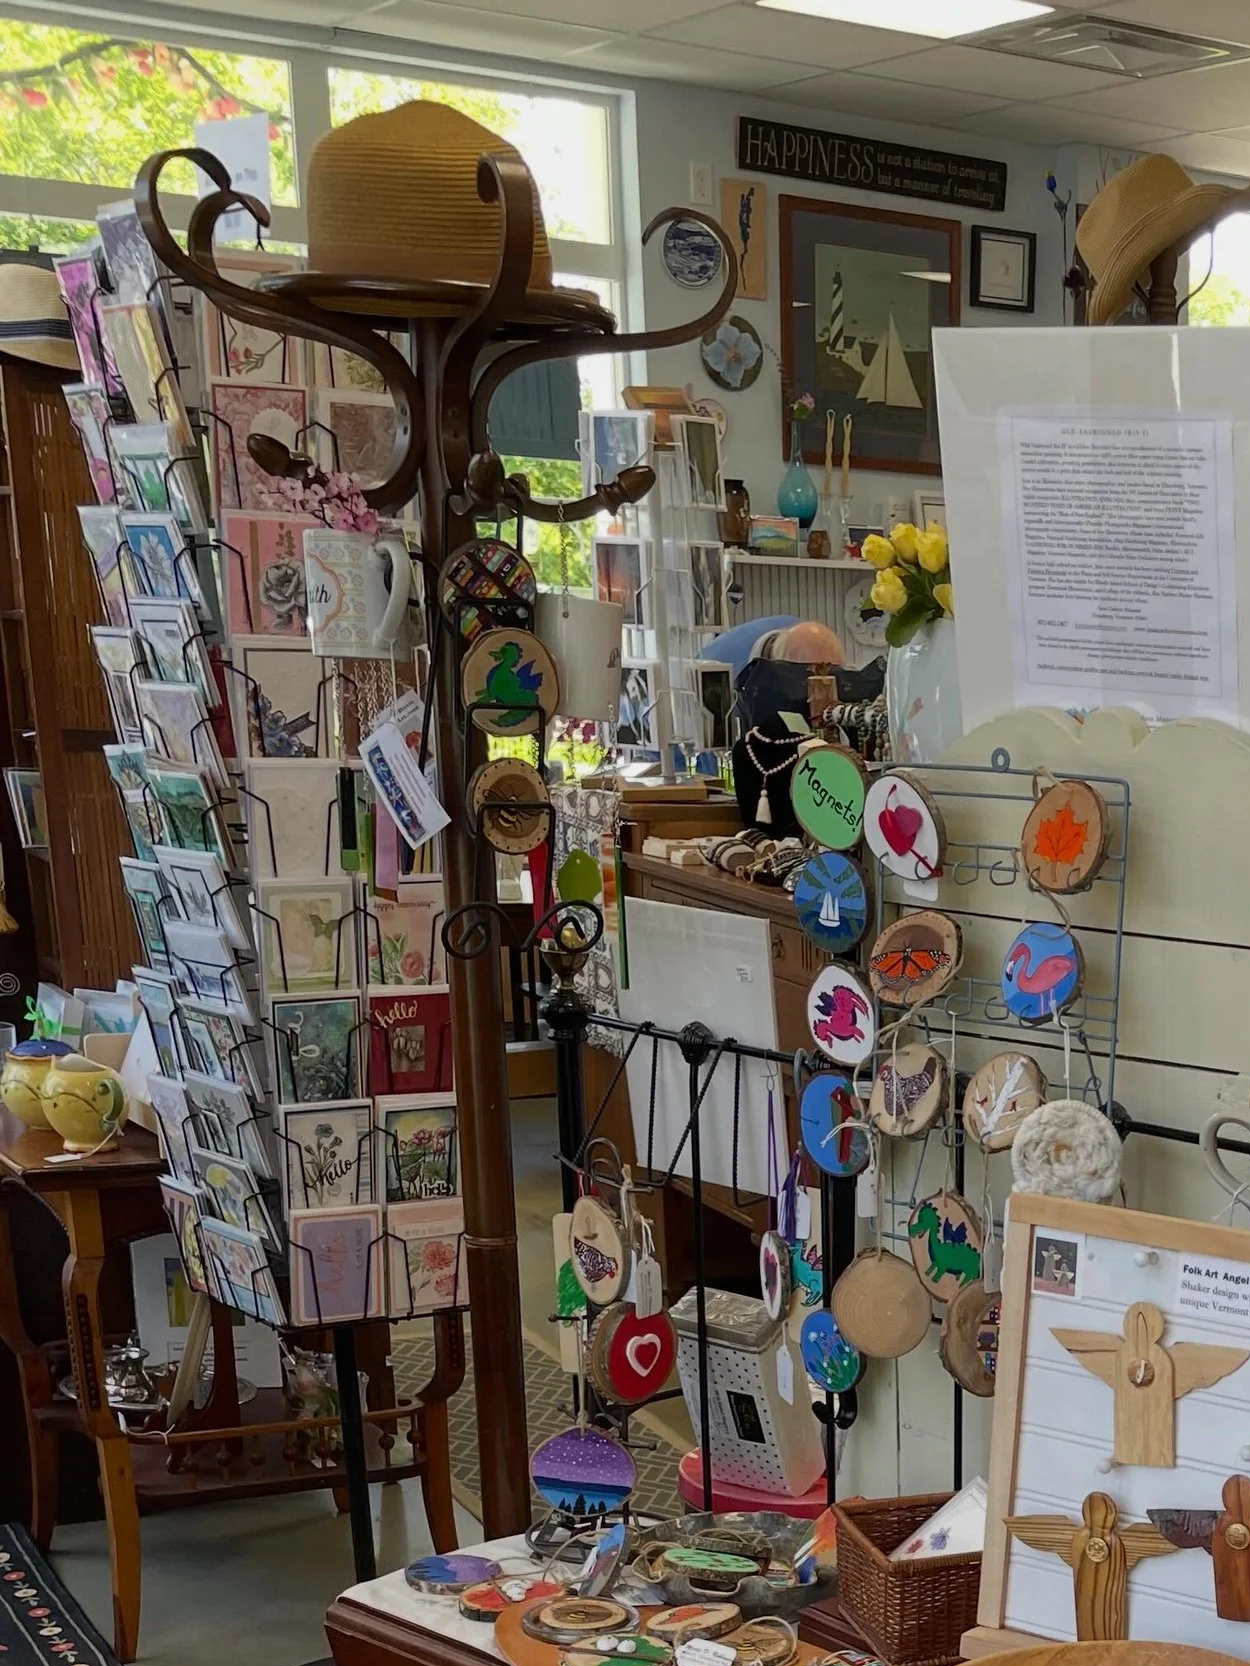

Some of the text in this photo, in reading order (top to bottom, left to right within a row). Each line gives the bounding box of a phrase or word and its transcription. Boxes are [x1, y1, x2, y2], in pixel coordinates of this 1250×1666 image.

[746, 125, 875, 184] HAPPINESS
[798, 758, 864, 832] Magnets!
[374, 1000, 418, 1028] hello
[305, 1157, 359, 1189] hello
[423, 1180, 453, 1199] hello
[1183, 1264, 1202, 1276] Folk
[1204, 1269, 1218, 1279] Art
[1222, 1272, 1250, 1285] Angel
[1181, 1280, 1211, 1294] Shaker
[1212, 1286, 1239, 1301] design
[1179, 1297, 1210, 1311] unique
[1212, 1301, 1249, 1317] Vermont
